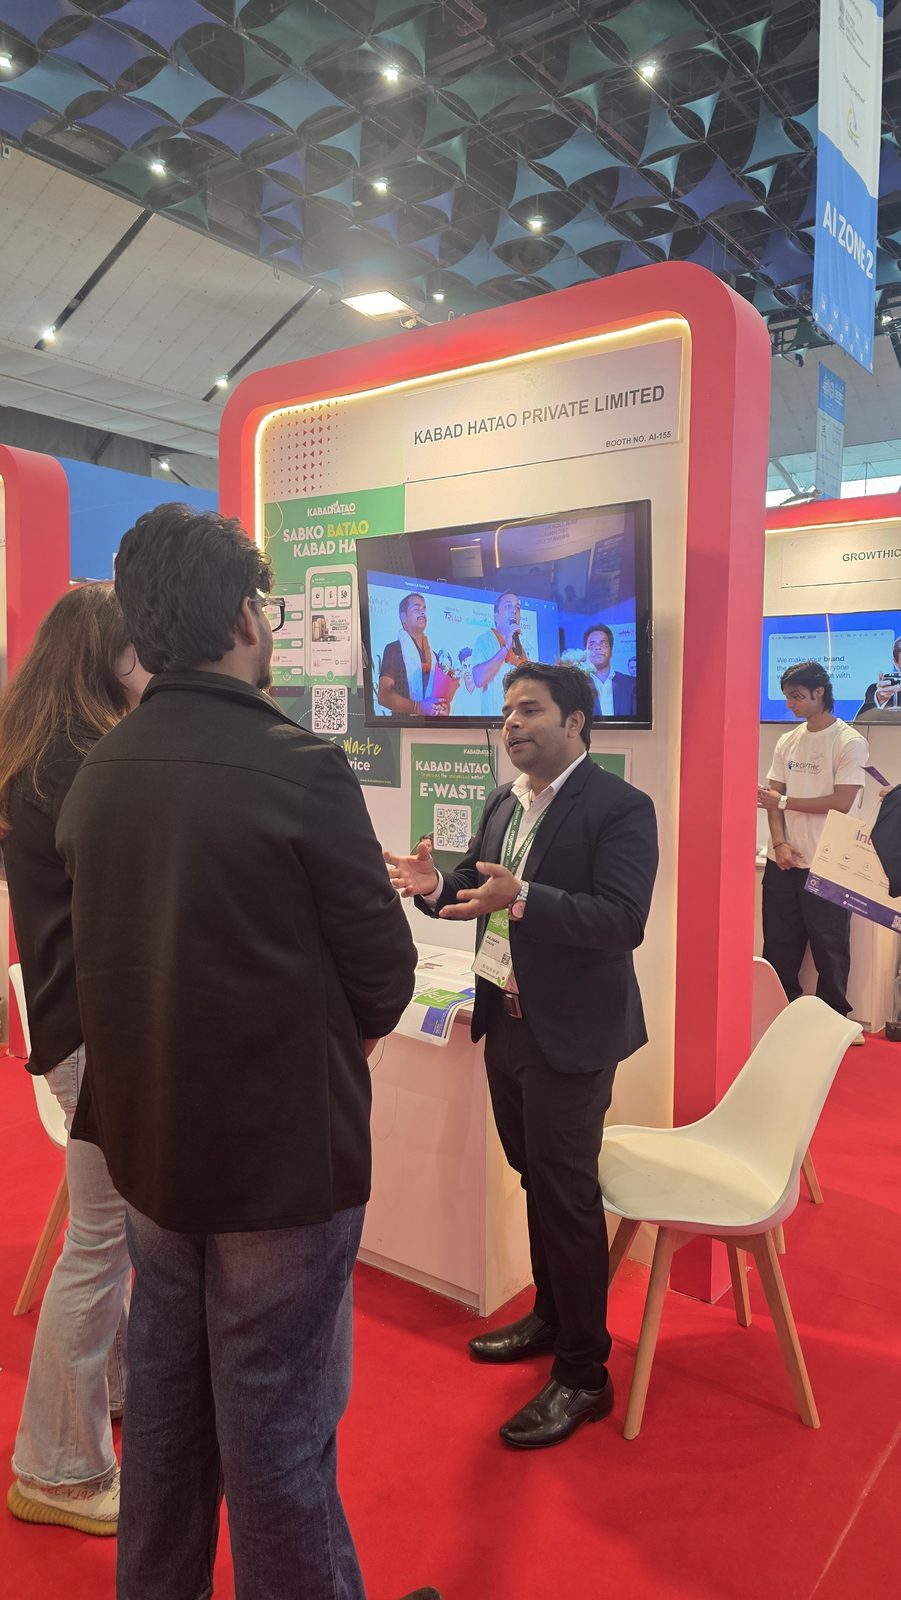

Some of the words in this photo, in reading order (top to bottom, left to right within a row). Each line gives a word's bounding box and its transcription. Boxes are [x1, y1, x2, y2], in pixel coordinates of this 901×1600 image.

[822, 200, 837, 238] AI
[838, 214, 866, 272] ZONE
[865, 249, 874, 279] 2
[414, 423, 463, 445] KABAD
[467, 412, 517, 436] HATAO
[522, 399, 589, 426] PRIVATE
[595, 385, 665, 413] LIMITED
[606, 437, 632, 448] BOOTH
[633, 435, 646, 443] NO.
[648, 431, 672, 441] AI-155
[283, 525, 324, 542] SABKO
[327, 519, 369, 538] BATAO
[293, 540, 336, 558] KABAD
[842, 548, 901, 562] GROWTHIC
[347, 757, 371, 771] rice
[416, 761, 452, 772] KABAD
[455, 762, 491, 774] HATAO
[420, 782, 486, 801] E-WASTE
